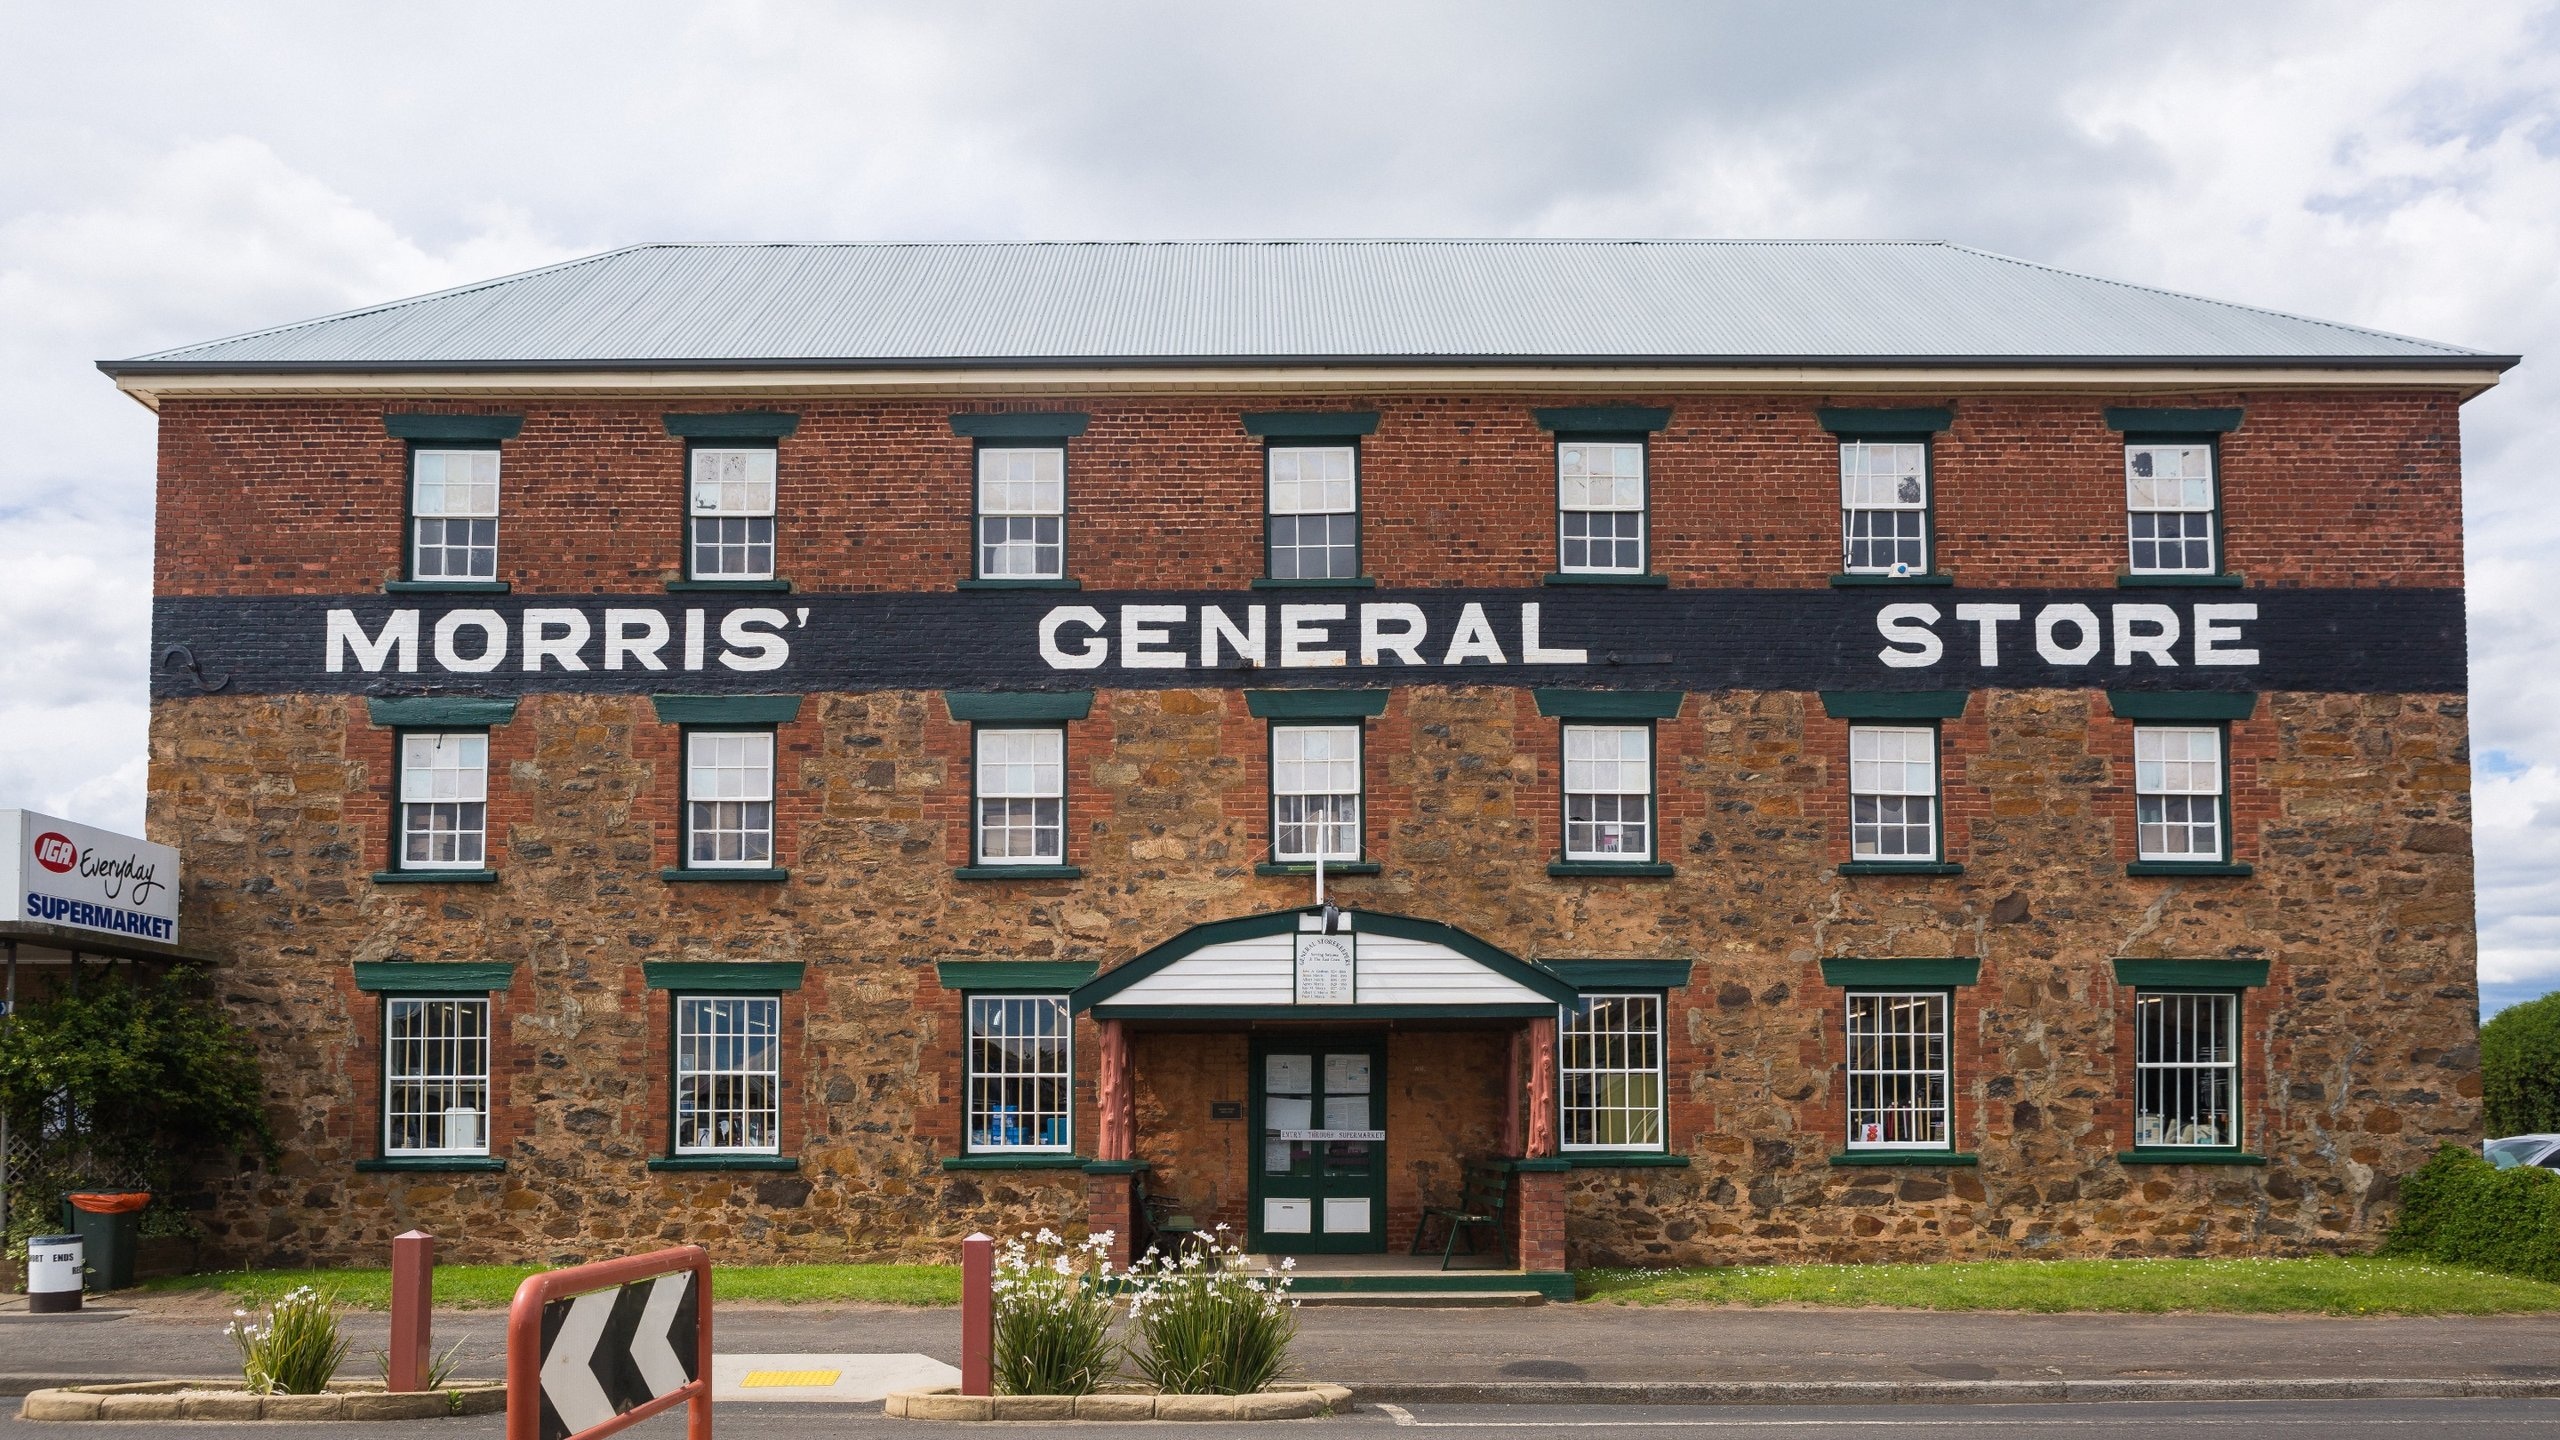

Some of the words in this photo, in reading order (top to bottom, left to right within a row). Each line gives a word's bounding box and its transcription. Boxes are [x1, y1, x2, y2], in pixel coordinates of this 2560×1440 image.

[324, 607, 811, 673] MORRIS'
[1038, 602, 1588, 670] GENERAL
[1876, 603, 2260, 668] STORE
[38, 837, 73, 865] IGA
[80, 848, 165, 905] Everyday
[27, 892, 173, 940] SUPERMARKET
[52, 1253, 74, 1262] ENDS
